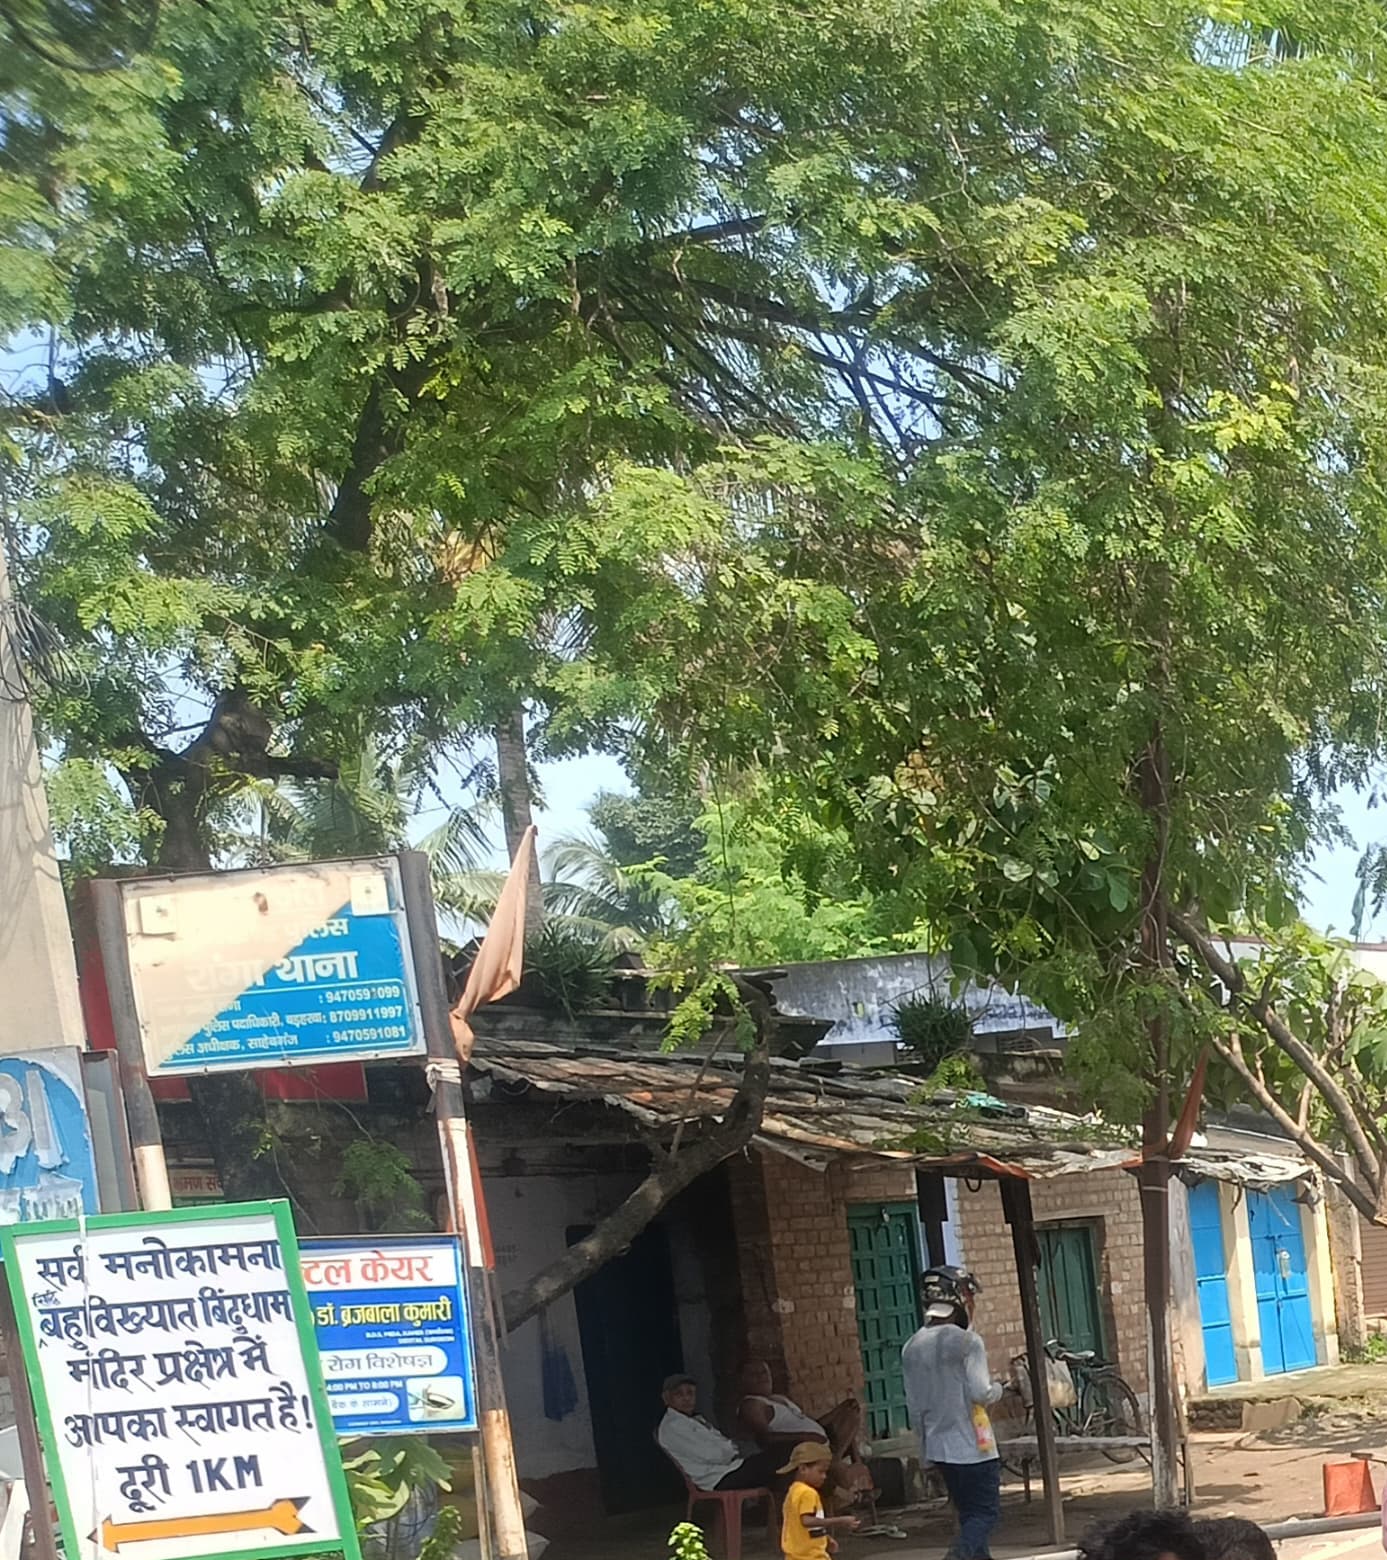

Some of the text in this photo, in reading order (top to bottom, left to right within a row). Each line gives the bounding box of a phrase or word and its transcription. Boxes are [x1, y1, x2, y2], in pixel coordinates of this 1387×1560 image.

[275, 950, 359, 983] थाना
[329, 1005, 403, 1023] 8709911997
[332, 1025, 406, 1043] 9470591081
[36, 1237, 282, 1291] सर्व मनोकामना
[300, 1250, 434, 1286] टल केयर
[316, 1295, 452, 1328] डॉ. ब्रजबाला कुमारी
[67, 1348, 156, 1394] मंदिर
[232, 1335, 278, 1376] में
[327, 1352, 434, 1373] रोग विशेषज्ञ
[64, 1408, 171, 1448] आपका
[172, 1398, 276, 1446] स्वागत
[116, 1454, 172, 1512] दूरी
